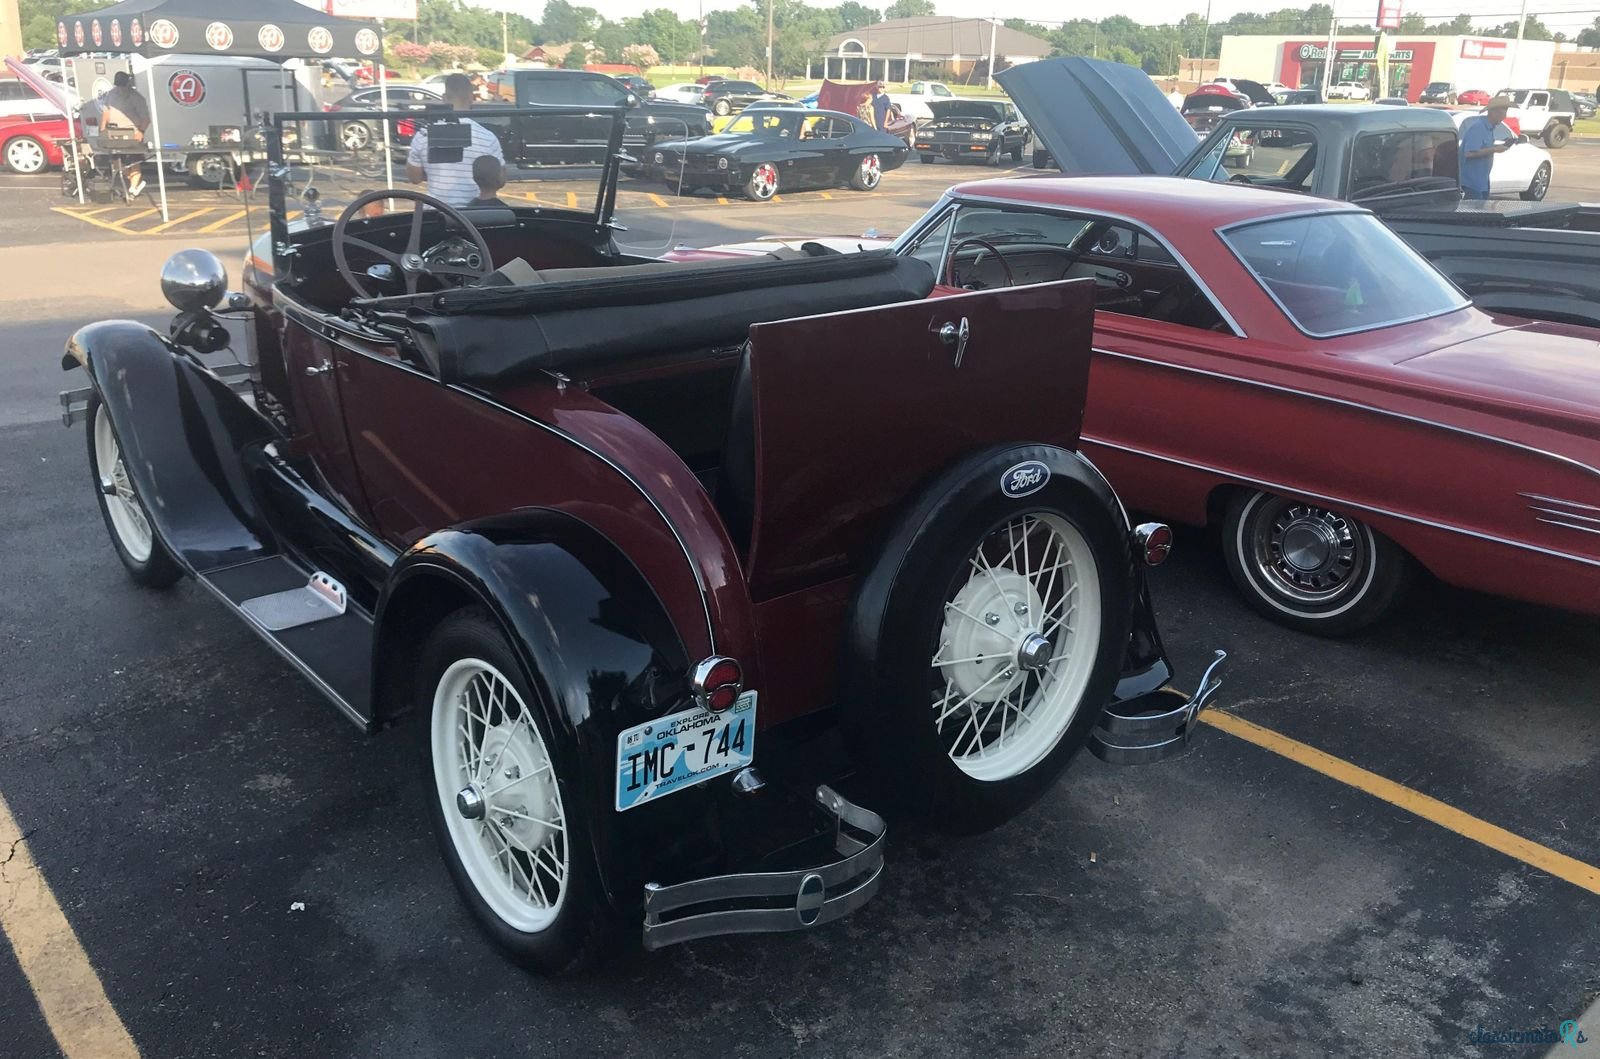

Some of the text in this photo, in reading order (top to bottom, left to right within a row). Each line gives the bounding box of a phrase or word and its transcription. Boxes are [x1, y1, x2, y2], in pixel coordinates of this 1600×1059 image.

[1010, 467, 1042, 491] Ford
[656, 714, 721, 740] OKLAHOMA
[670, 711, 710, 728] EXPLORE
[655, 763, 720, 789] TRAVELOK.COM
